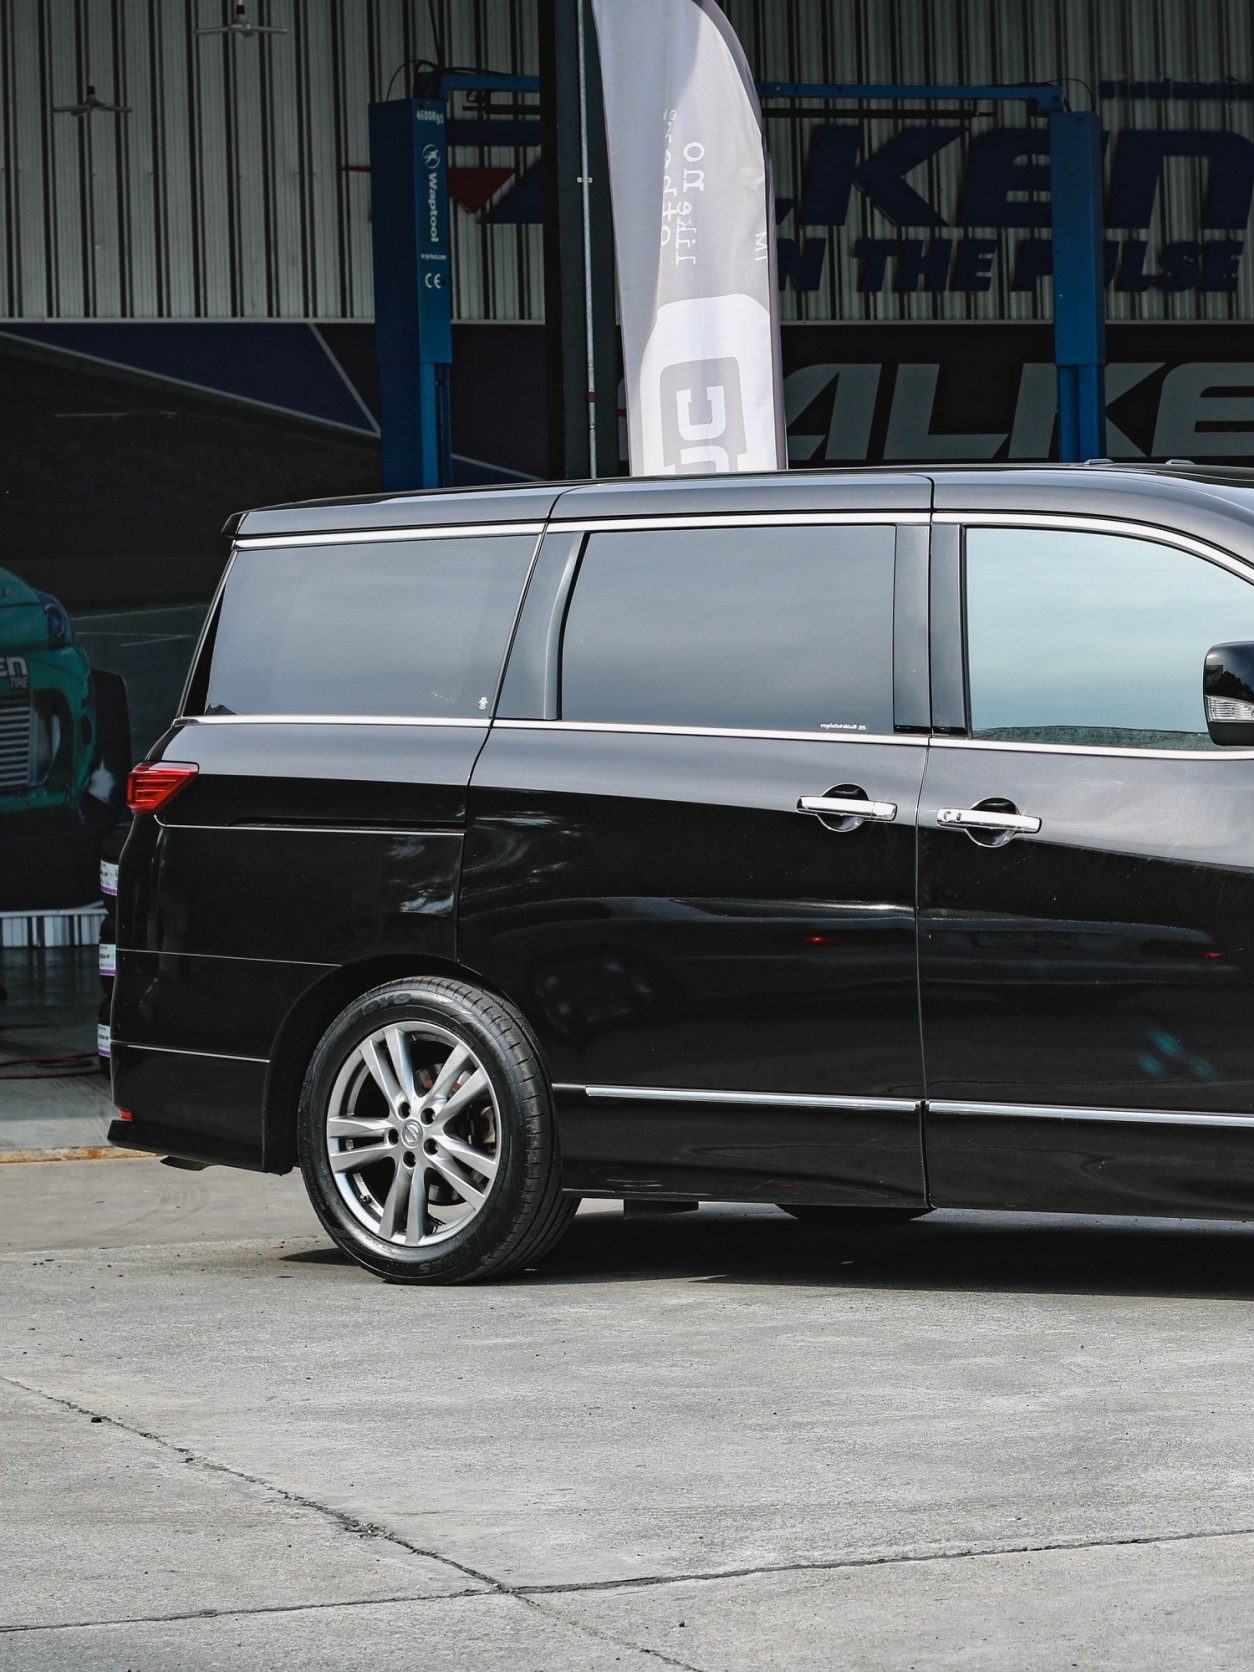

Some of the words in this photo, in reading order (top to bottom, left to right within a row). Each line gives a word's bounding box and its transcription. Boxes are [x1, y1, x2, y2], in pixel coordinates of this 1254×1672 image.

[428, 172, 439, 242] Waptool
[777, 238, 826, 291] N
[853, 238, 998, 292] THE
